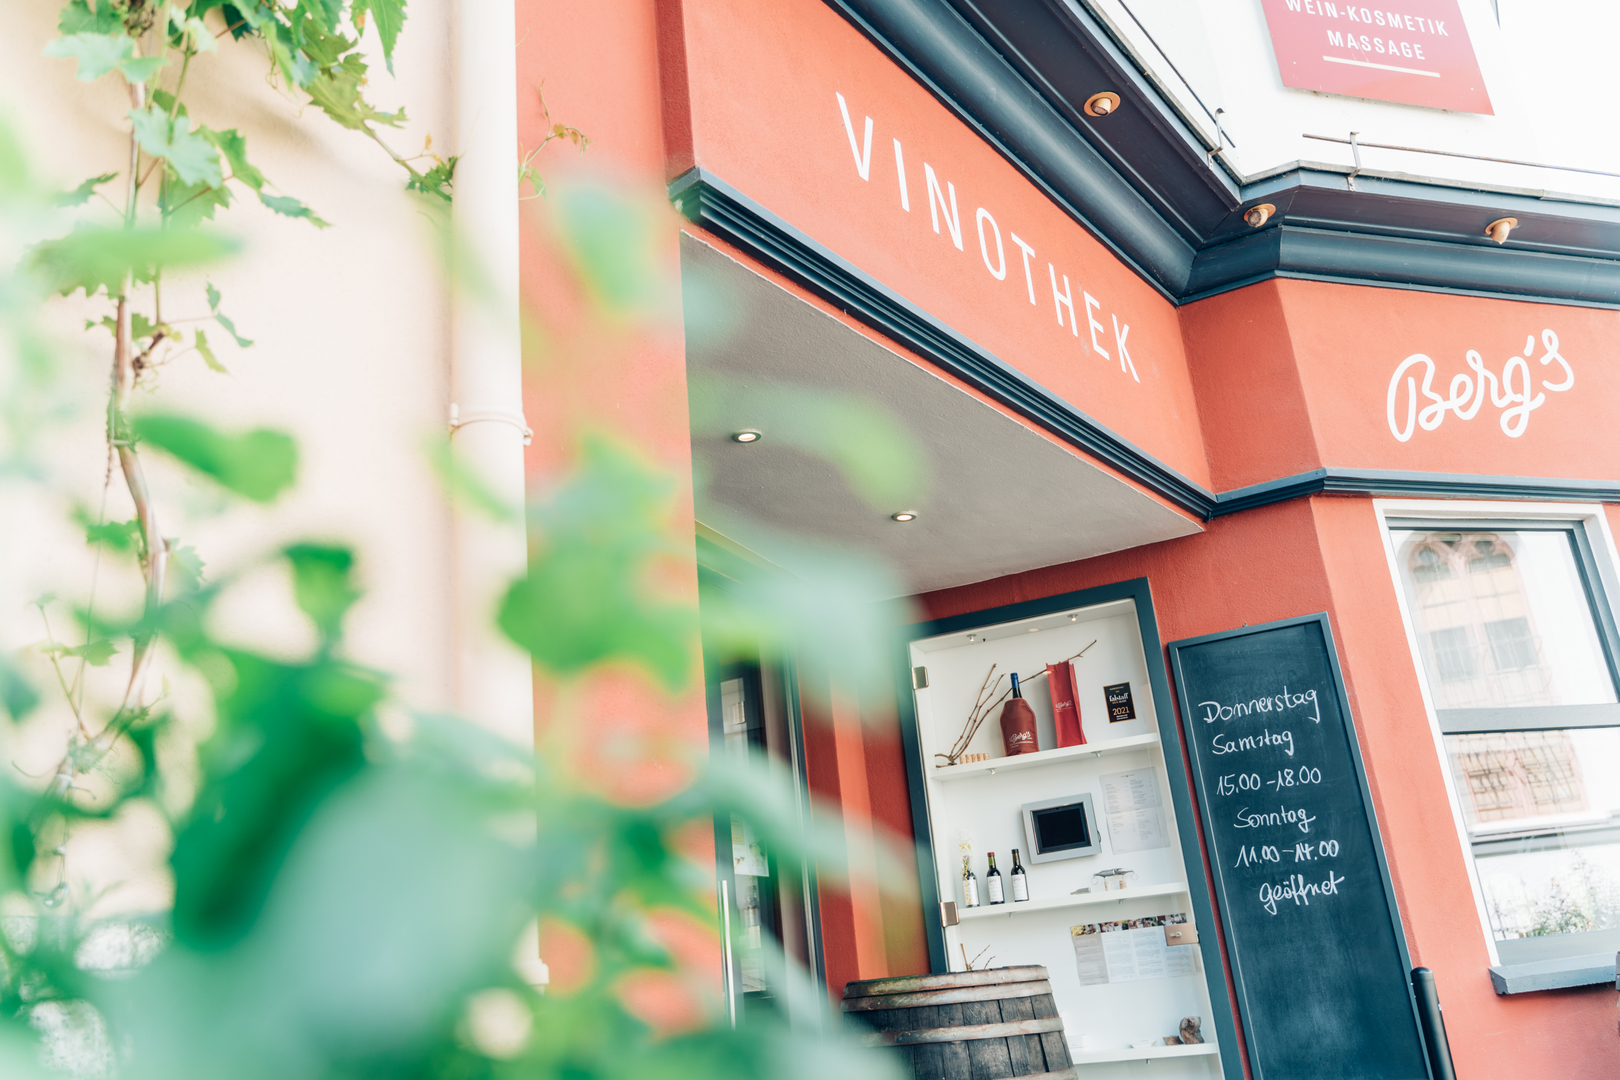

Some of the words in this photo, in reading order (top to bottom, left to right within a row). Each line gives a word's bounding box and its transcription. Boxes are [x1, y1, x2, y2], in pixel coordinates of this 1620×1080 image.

[1285, 0, 1449, 37] WEIN-KOSMETIK
[1326, 29, 1426, 60] MASSAGE
[835, 90, 1141, 384] VINOTHEK
[1386, 328, 1575, 443] Berg's
[1112, 706, 1130, 716] 2021
[1197, 685, 1321, 724] Donnerstag
[1212, 728, 1295, 757] Samstag
[1233, 805, 1317, 834] Sonntag
[1259, 870, 1346, 916] geöffnet
